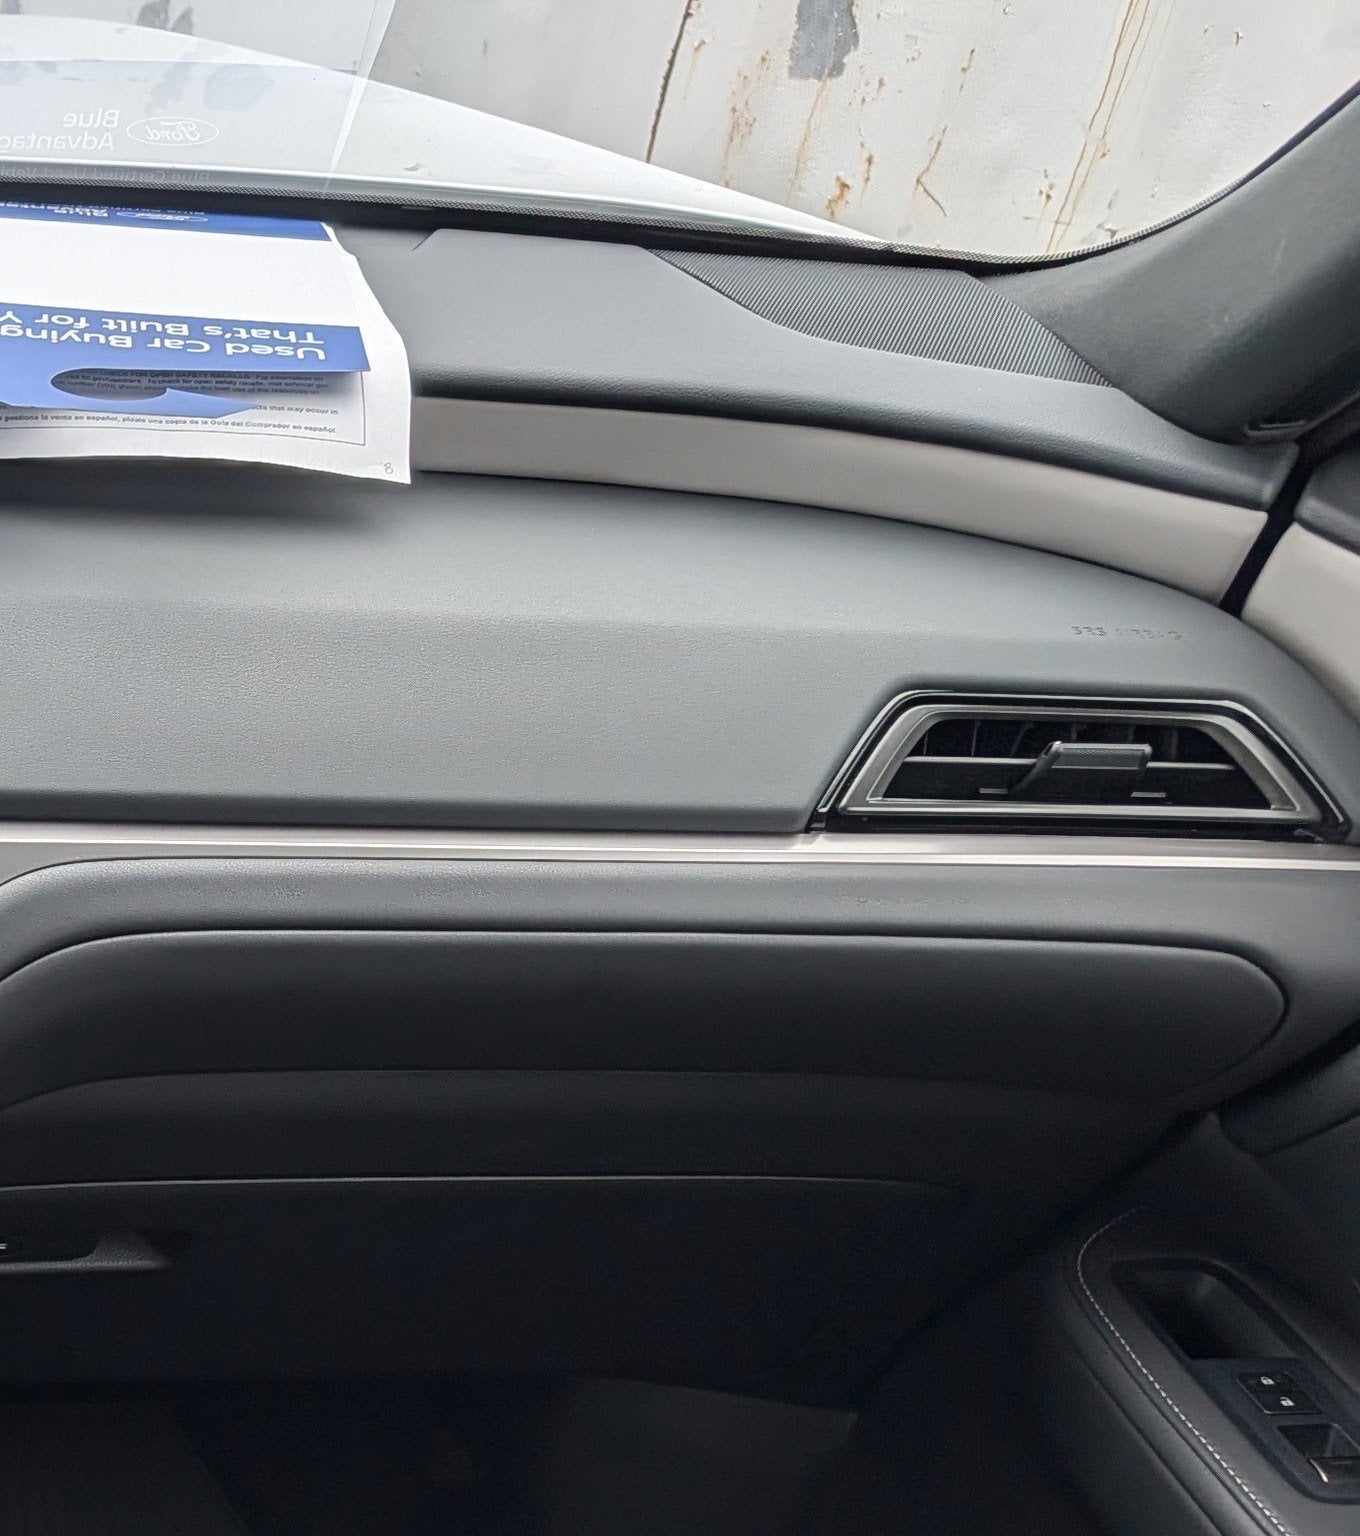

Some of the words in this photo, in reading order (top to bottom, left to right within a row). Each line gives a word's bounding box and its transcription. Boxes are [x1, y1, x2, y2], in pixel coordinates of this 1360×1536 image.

[34, 313, 91, 330] for
[101, 318, 190, 336] Built
[0, 323, 133, 349] Buying
[203, 325, 325, 345] That's
[146, 337, 211, 353] Car
[225, 341, 327, 361] Used
